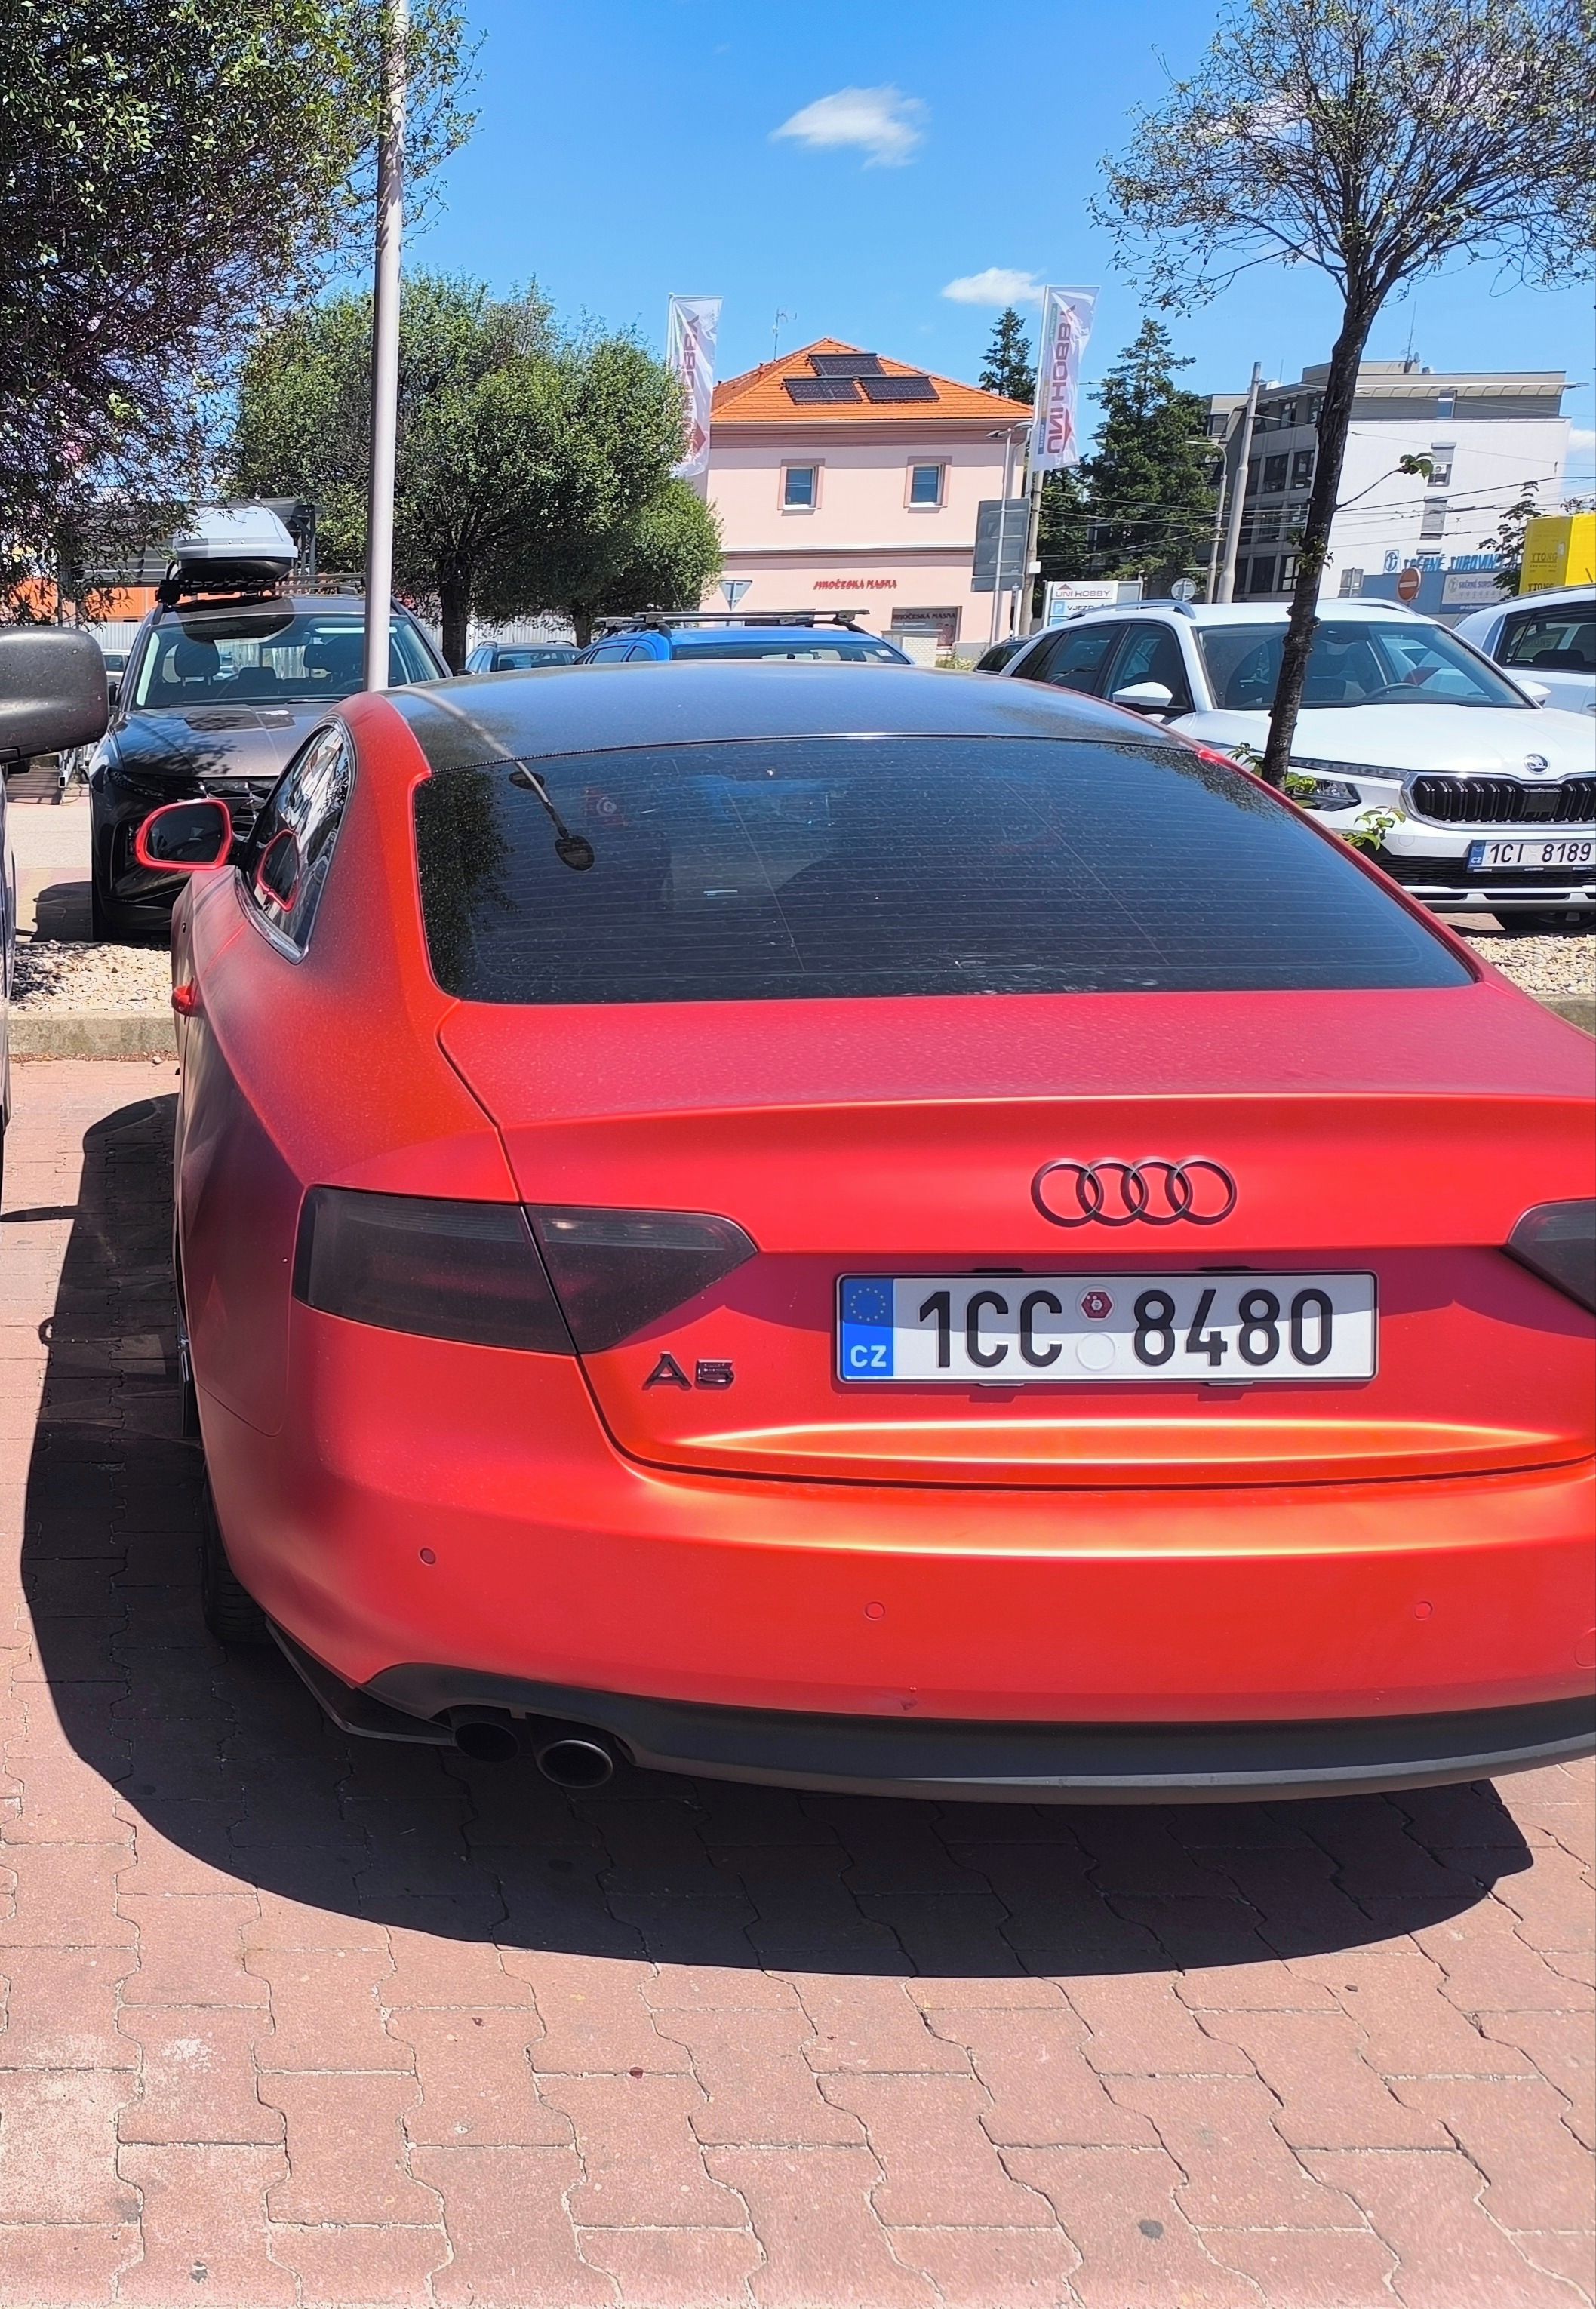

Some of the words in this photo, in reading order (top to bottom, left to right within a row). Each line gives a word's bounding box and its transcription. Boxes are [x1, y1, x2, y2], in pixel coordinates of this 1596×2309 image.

[1448, 553, 1507, 570] SUROVIN
[1531, 552, 1558, 561] YTONG
[1490, 844, 1524, 864] 1CI
[1542, 842, 1592, 863] 8189
[850, 1345, 887, 1368] CZ
[918, 1290, 1062, 1368] 1CC
[1133, 1288, 1333, 1367] 8480
[642, 1351, 735, 1391] A5
